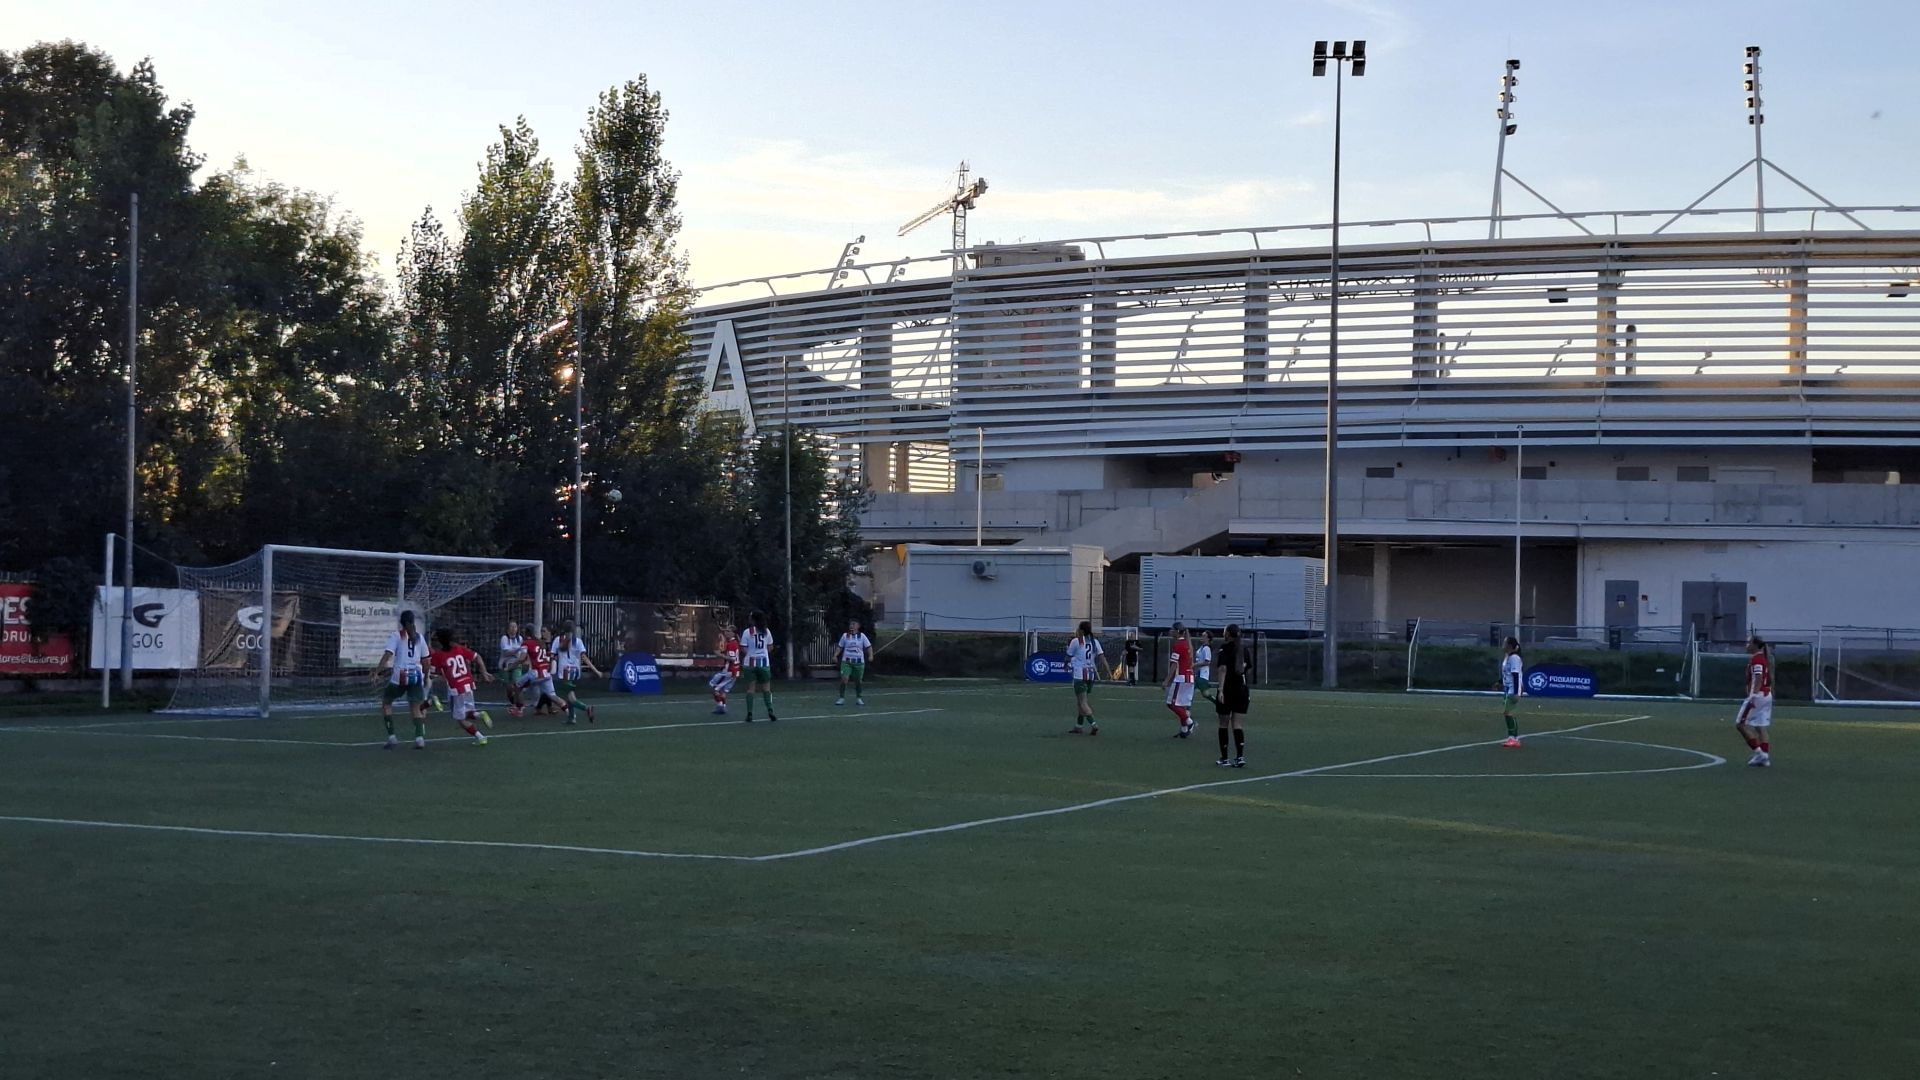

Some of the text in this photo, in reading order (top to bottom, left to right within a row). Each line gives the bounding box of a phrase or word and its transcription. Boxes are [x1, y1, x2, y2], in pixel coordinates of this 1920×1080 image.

[700, 319, 757, 434] A
[132, 632, 164, 649] GOG
[1085, 643, 1092, 660] 2
[446, 654, 468, 679] 29
